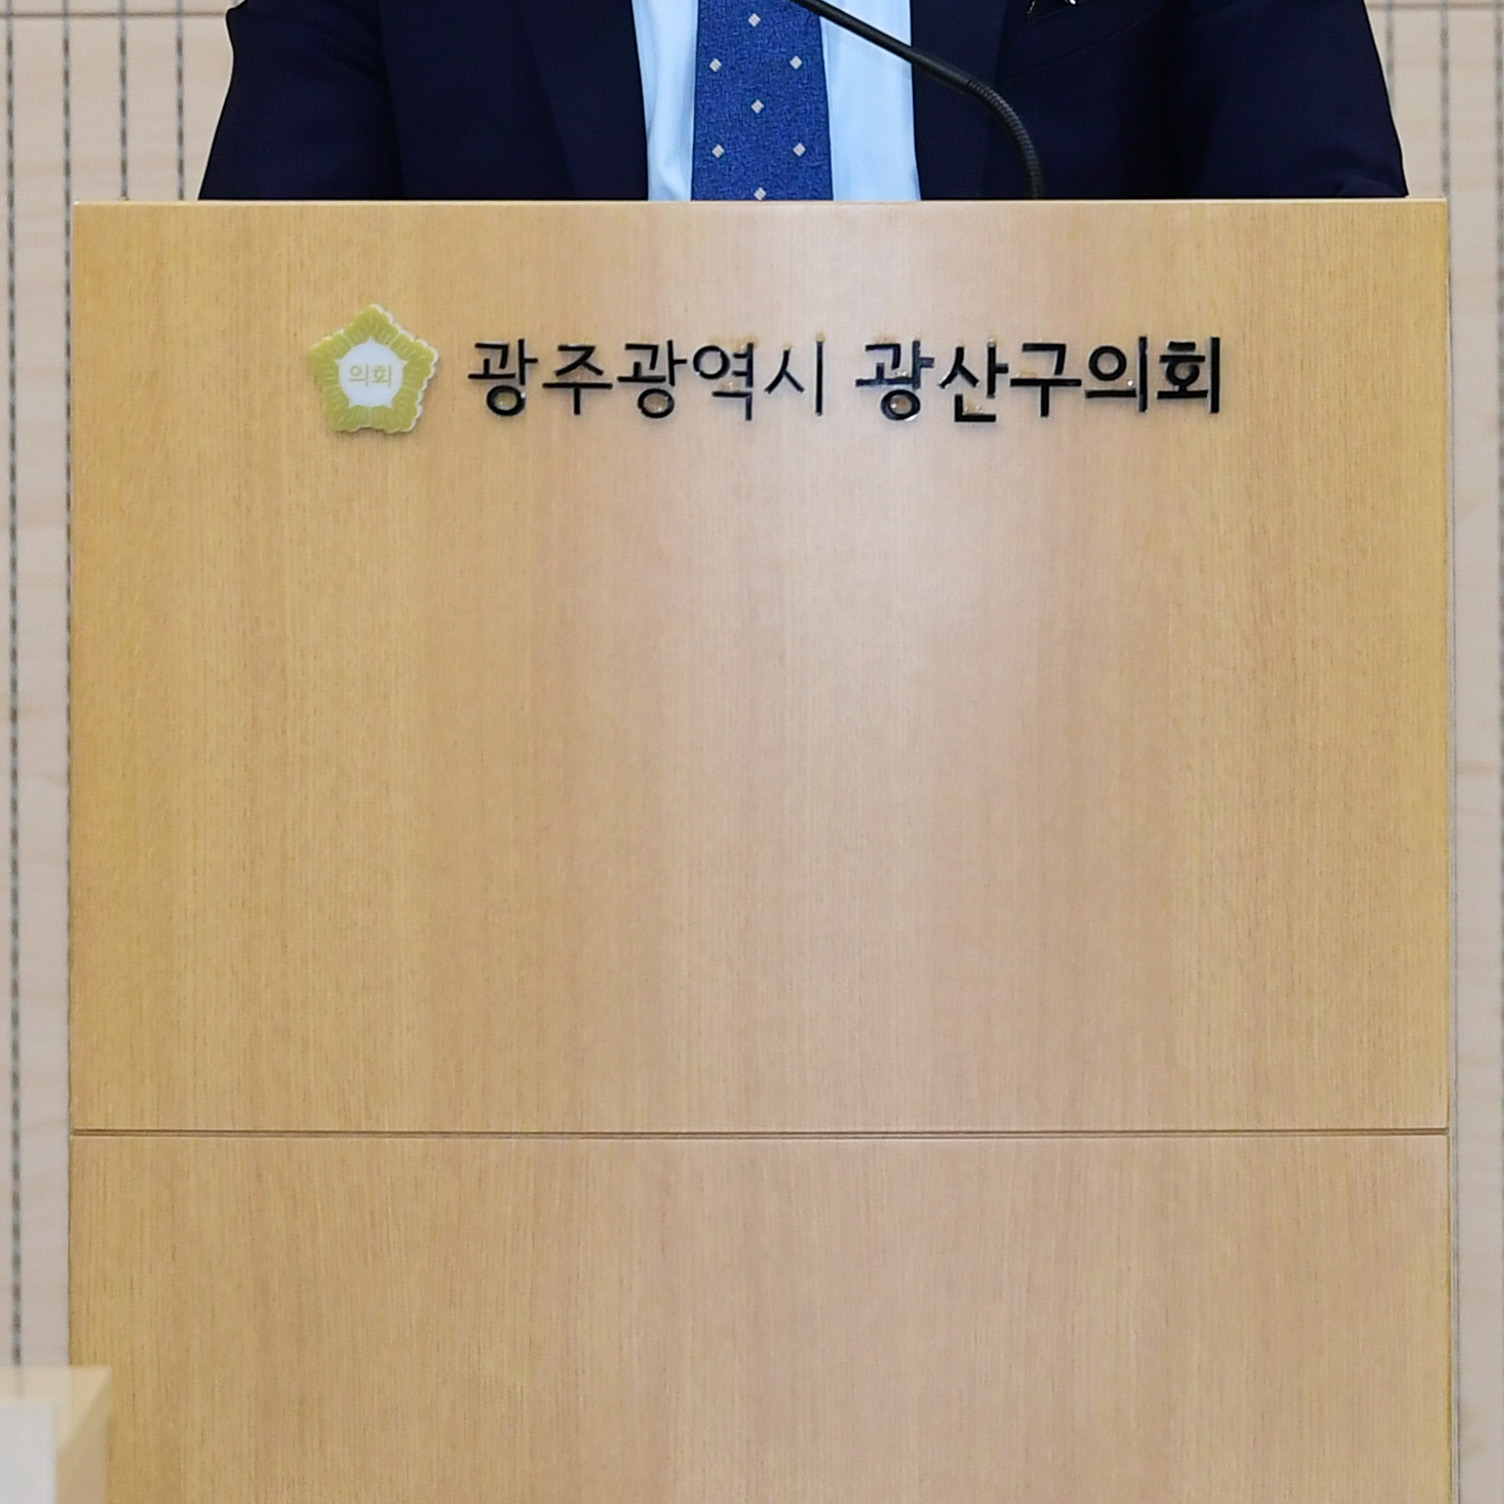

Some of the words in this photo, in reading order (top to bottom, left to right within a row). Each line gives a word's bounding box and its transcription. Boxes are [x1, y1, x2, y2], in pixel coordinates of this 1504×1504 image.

[348, 363, 392, 388] 의회
[467, 337, 825, 421] 광주광역시
[854, 335, 1223, 423] 광산구의회
